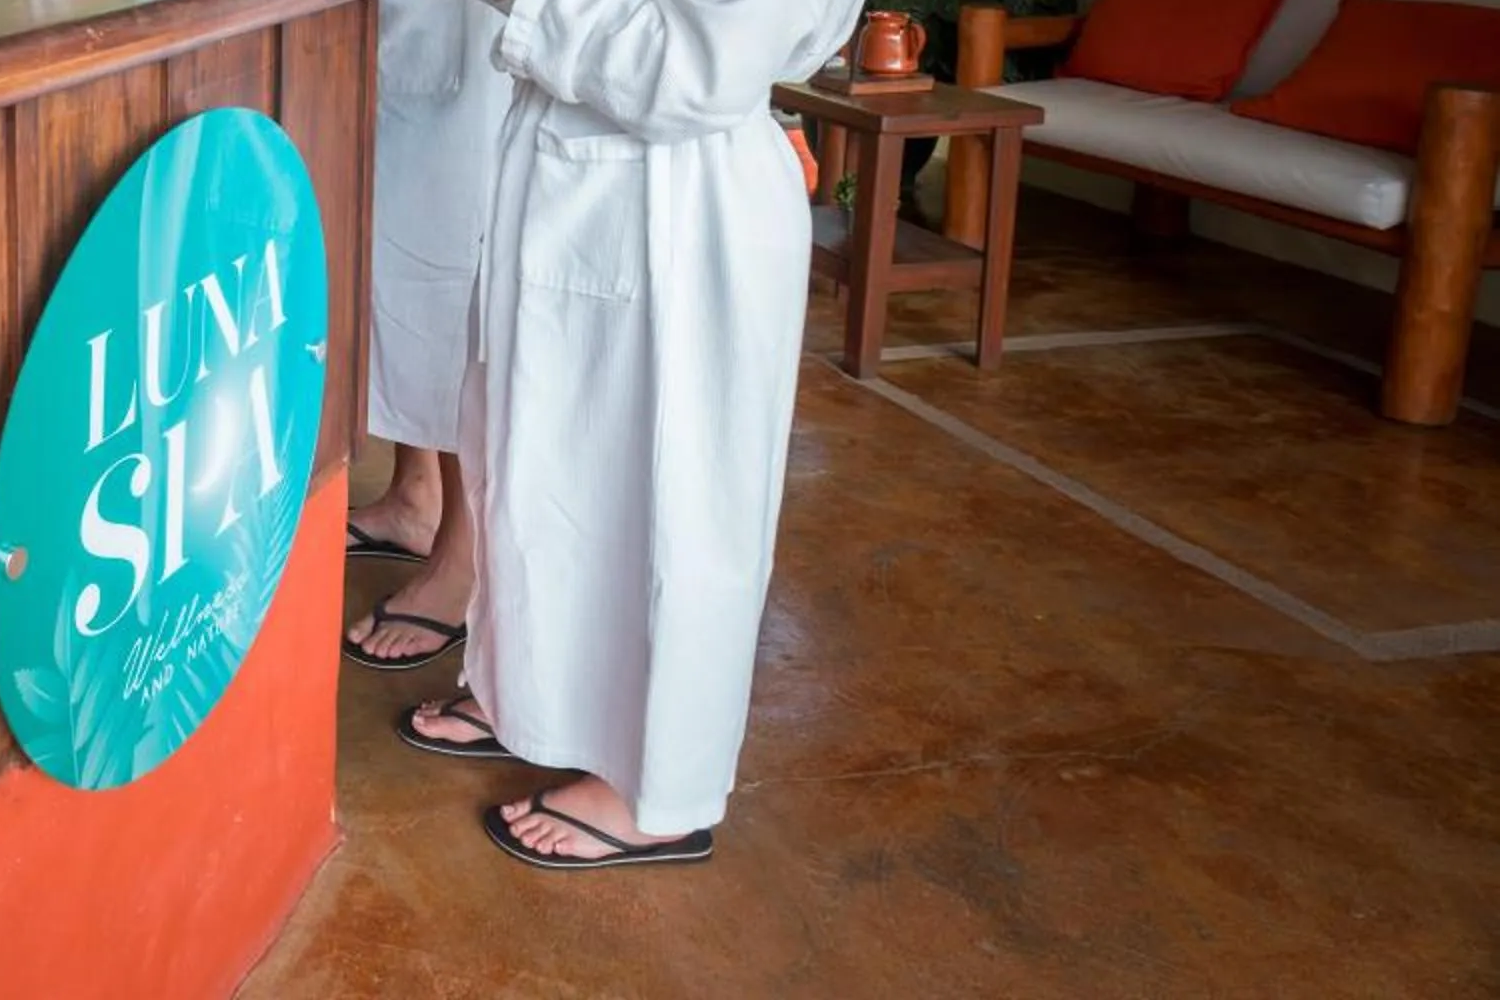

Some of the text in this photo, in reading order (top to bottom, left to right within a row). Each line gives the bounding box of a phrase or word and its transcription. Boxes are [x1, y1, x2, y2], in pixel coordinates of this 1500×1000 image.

[84, 238, 287, 453] LUNA
[74, 364, 285, 637] SPA
[140, 663, 174, 707] AND
